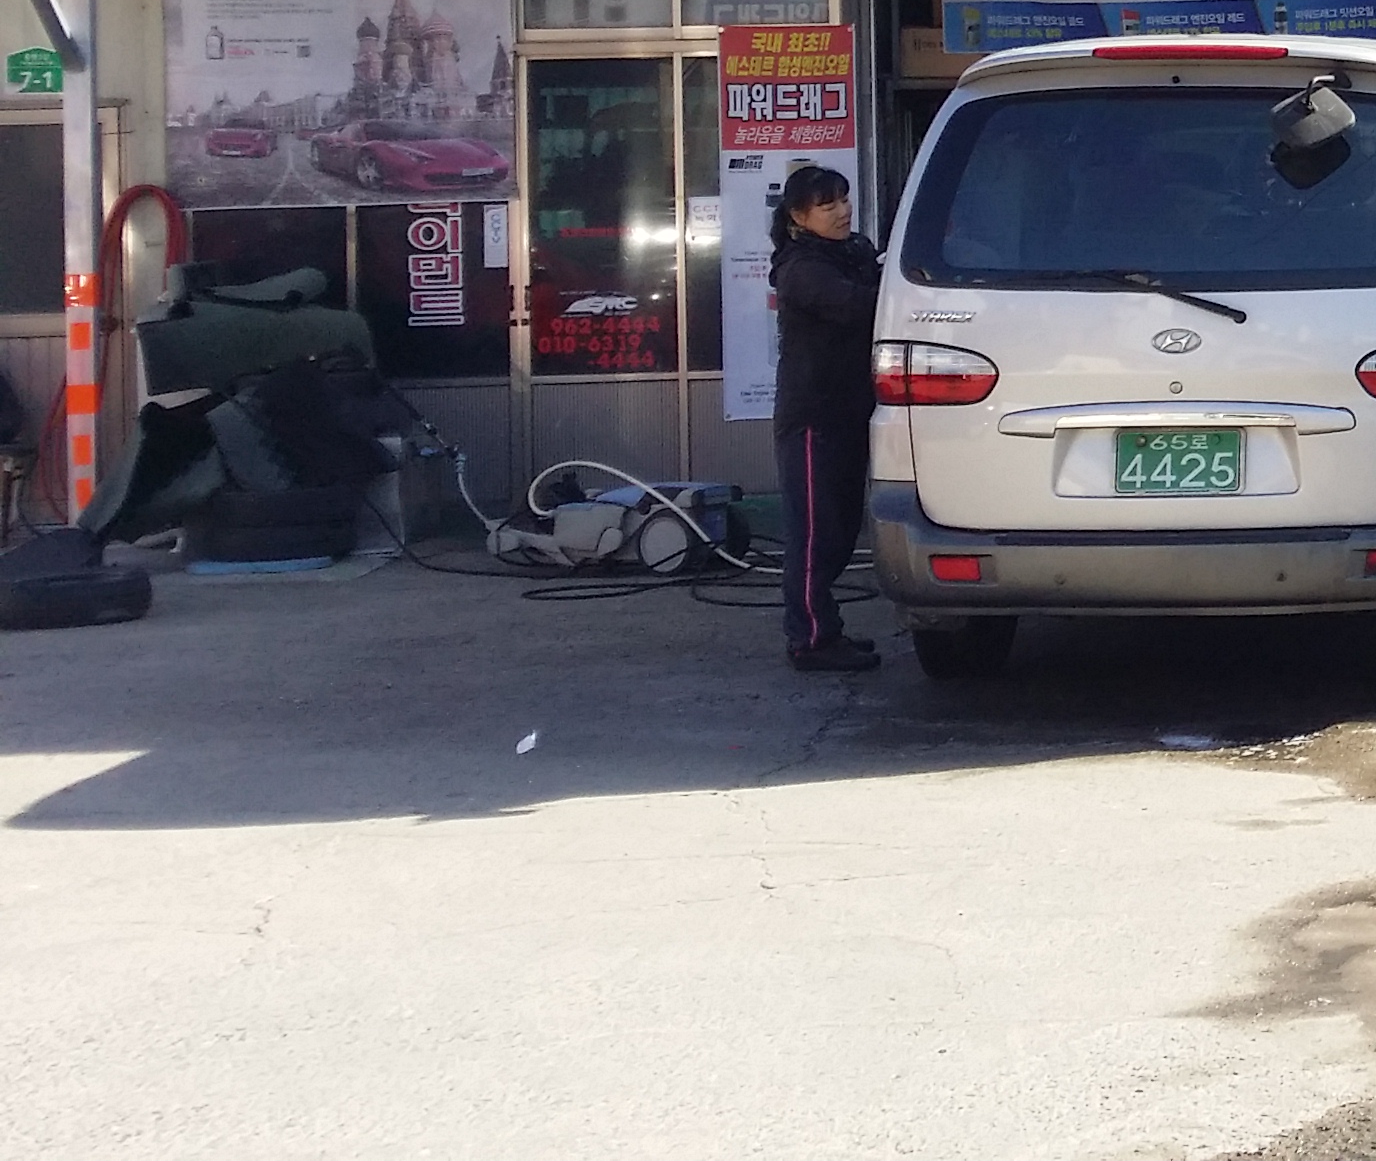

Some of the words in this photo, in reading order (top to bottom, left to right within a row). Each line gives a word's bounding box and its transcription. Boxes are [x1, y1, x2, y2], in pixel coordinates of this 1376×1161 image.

[751, 32, 783, 53] 국내
[726, 55, 775, 77] 에스테르
[778, 53, 850, 78] 합성엔진오일
[726, 82, 848, 121] 파워드래그
[733, 125, 785, 145] 놀라움을
[1149, 434, 1209, 451] 65로
[1120, 452, 1236, 489] 4425
